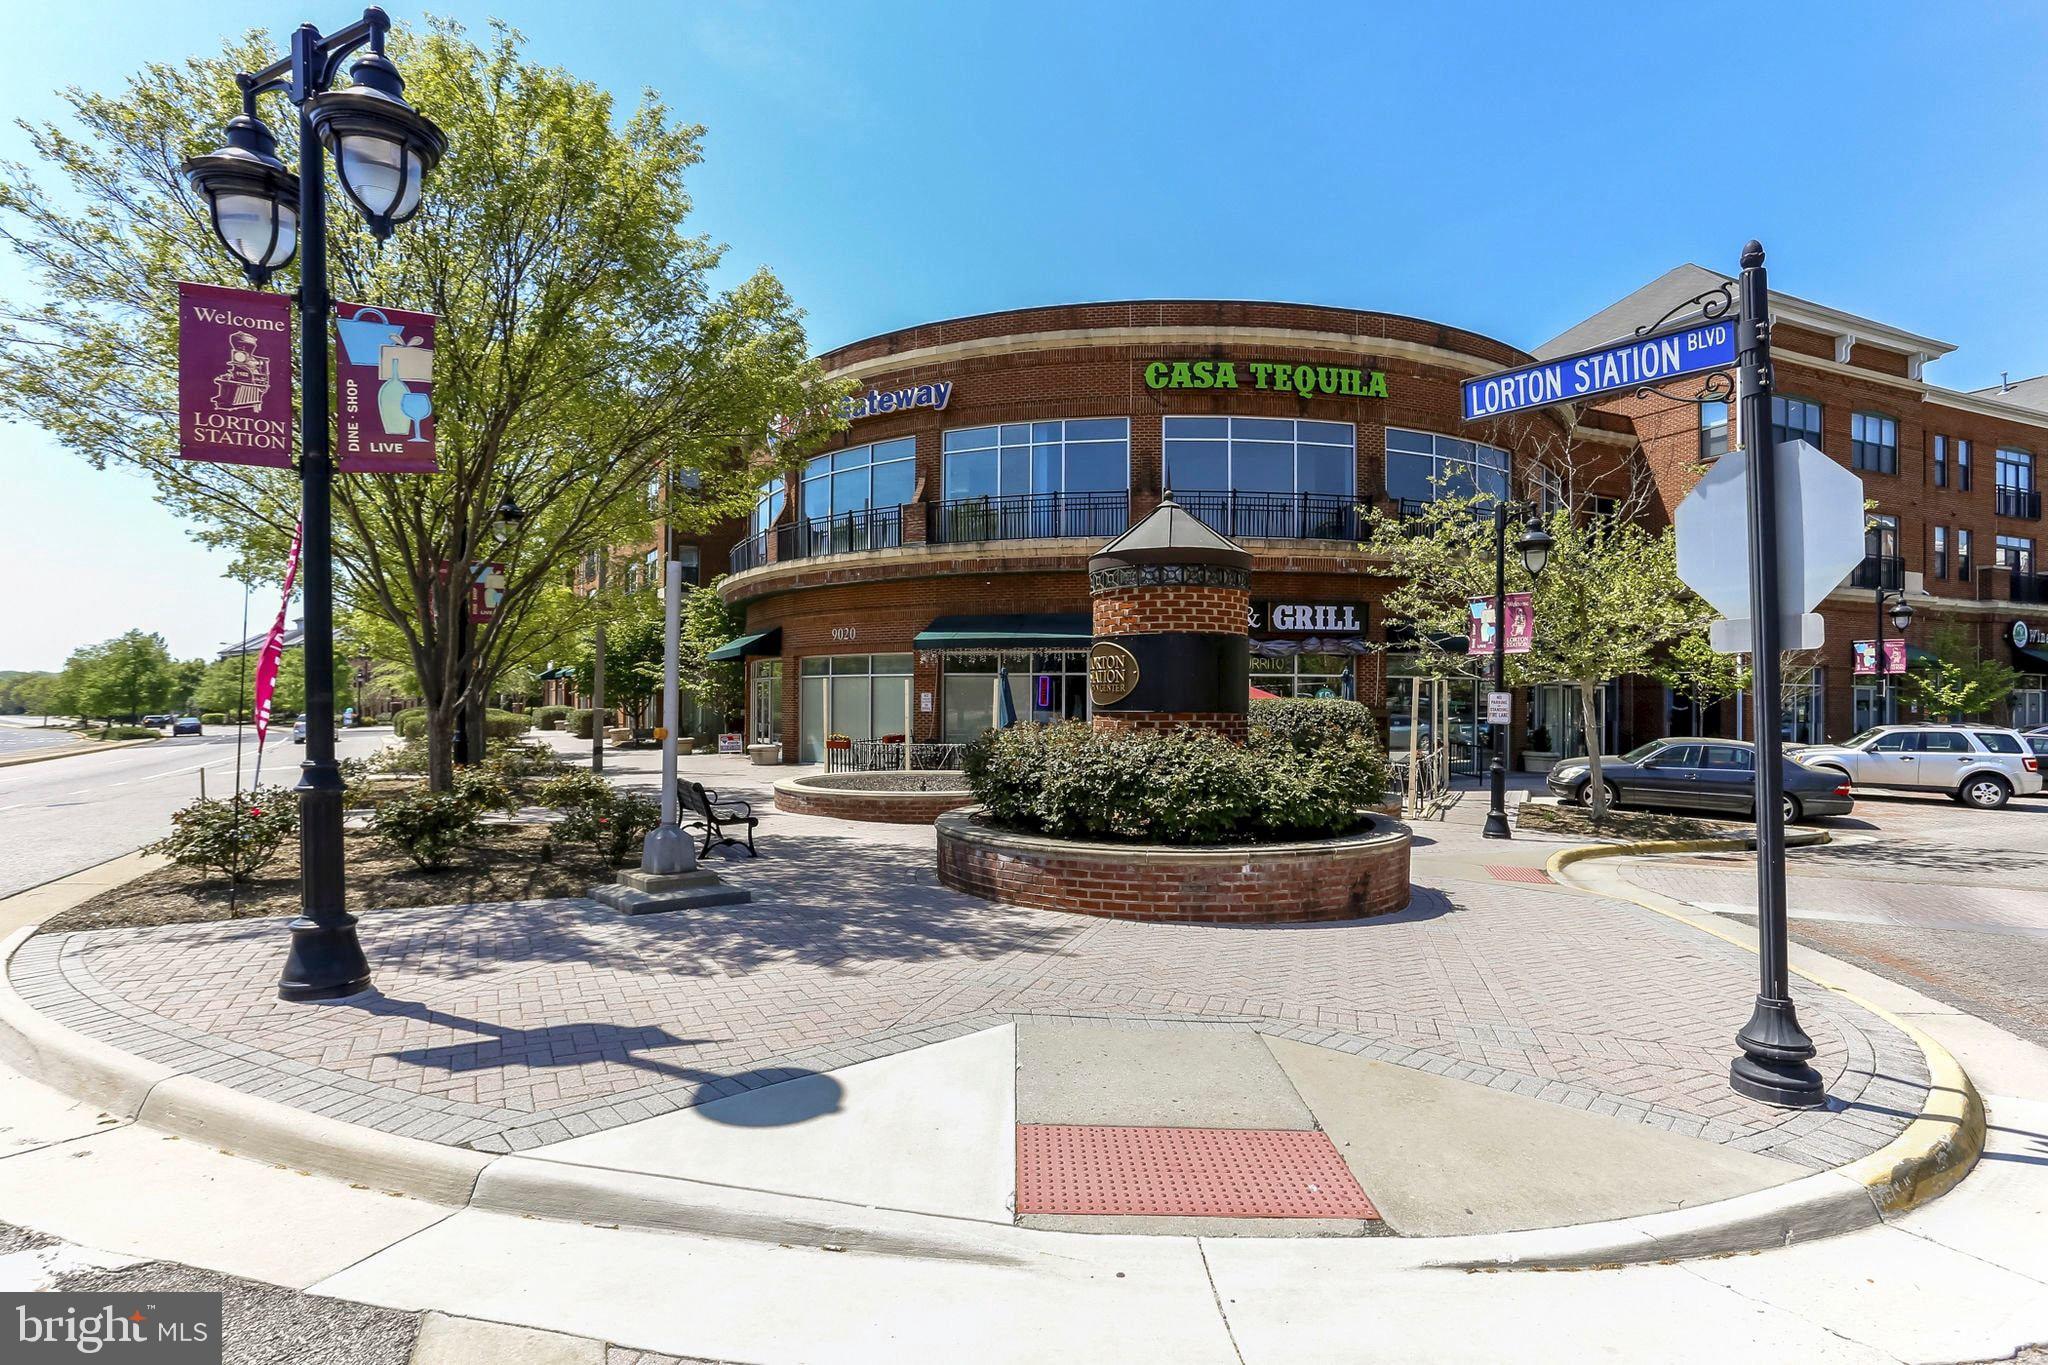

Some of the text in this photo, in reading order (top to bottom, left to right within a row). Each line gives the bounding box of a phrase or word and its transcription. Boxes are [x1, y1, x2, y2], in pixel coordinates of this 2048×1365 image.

[193, 306, 285, 332] Welcome
[1144, 361, 1389, 398] CASA TEQUILA
[1471, 326, 1726, 415] LORTON STATION BLVD
[194, 412, 285, 434] LORTON
[347, 379, 359, 452] DINE SHOP
[194, 428, 285, 450] STATION
[370, 442, 404, 453] LIVE
[1271, 604, 1361, 631] GRILL
[831, 627, 856, 641] 9020
